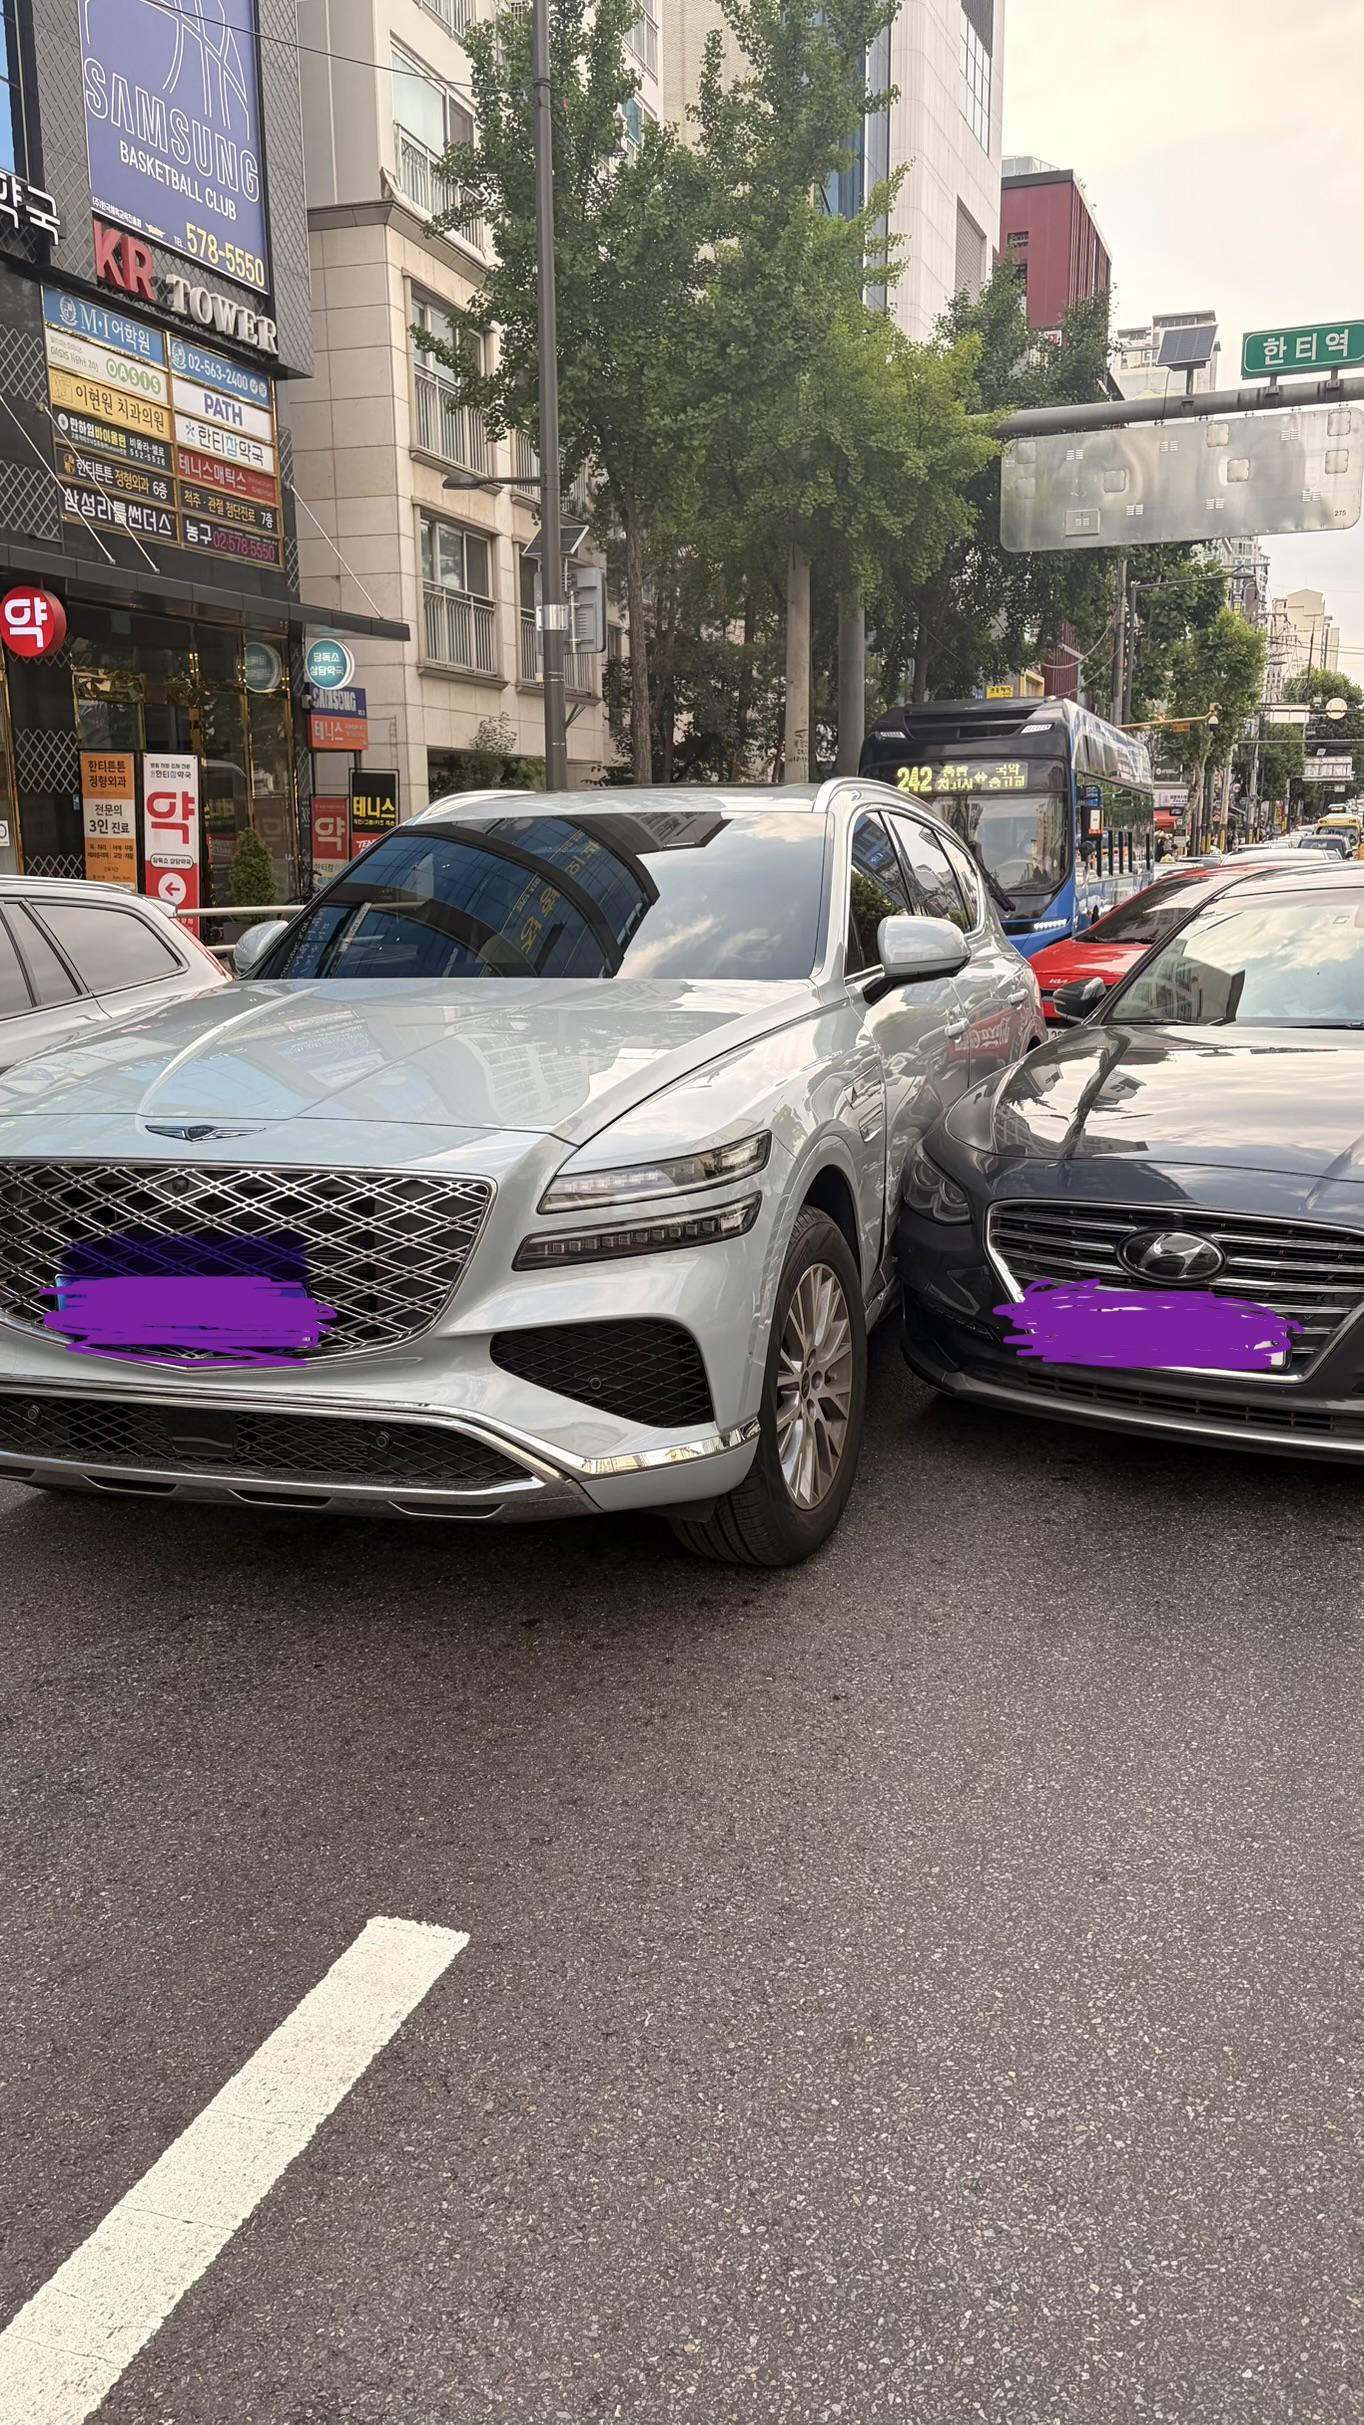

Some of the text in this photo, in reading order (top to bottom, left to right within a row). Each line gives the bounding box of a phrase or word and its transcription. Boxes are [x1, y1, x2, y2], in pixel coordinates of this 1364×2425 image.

[84, 58, 259, 202] SAMSUNG
[120, 140, 237, 220] BASKETBALL CLUB
[186, 222, 265, 287] 578-5550
[93, 218, 279, 355] KR TOWER
[1263, 329, 1349, 366] 한티역
[188, 353, 248, 391] 02-563-2400
[76, 384, 164, 433] 이현원 치과의원
[204, 393, 243, 426] PATH
[76, 458, 168, 499] 한티튼튼 정형외과 6층
[179, 453, 247, 490] 테니스매틱스
[64, 488, 172, 535] 삼성리틀썬더스
[261, 511, 274, 529] 7층
[1334, 509, 1347, 517] 275
[186, 520, 212, 544] 농구
[4, 597, 48, 648] 약
[310, 666, 344, 676] 상담약국
[315, 720, 344, 742] 테니스
[88, 760, 126, 773] 한티튼튼
[89, 775, 126, 788] 정형외과
[897, 766, 932, 792] 242
[95, 804, 122, 816] 전문의
[147, 791, 195, 844] 약
[352, 796, 395, 818] 테니스
[89, 819, 130, 834] 3인 진료
[314, 817, 345, 852] 약
